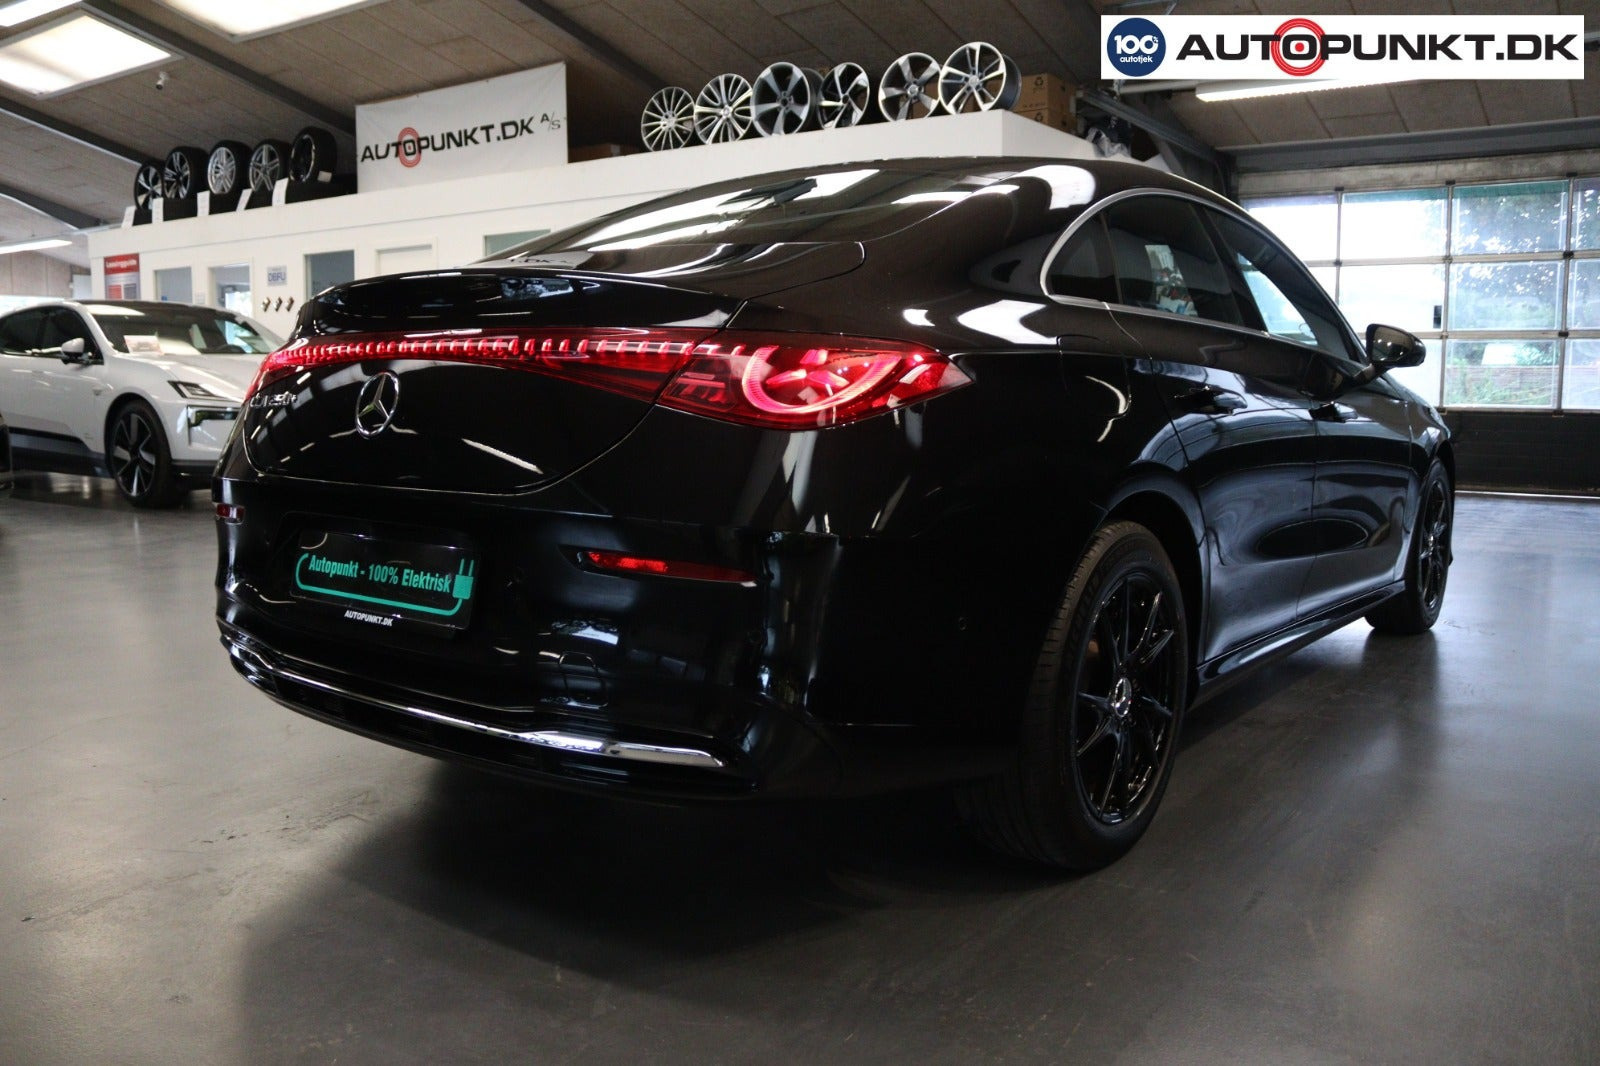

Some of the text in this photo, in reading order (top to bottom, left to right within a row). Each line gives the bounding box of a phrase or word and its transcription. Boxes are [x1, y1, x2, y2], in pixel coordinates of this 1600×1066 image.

[361, 116, 534, 162] AUTOPUNKT.DK
[309, 555, 358, 577] Autopunkt
[369, 564, 398, 584] 100%
[401, 569, 451, 592] Elektrisk
[344, 611, 393, 626] AUTOPUNKT.DK
